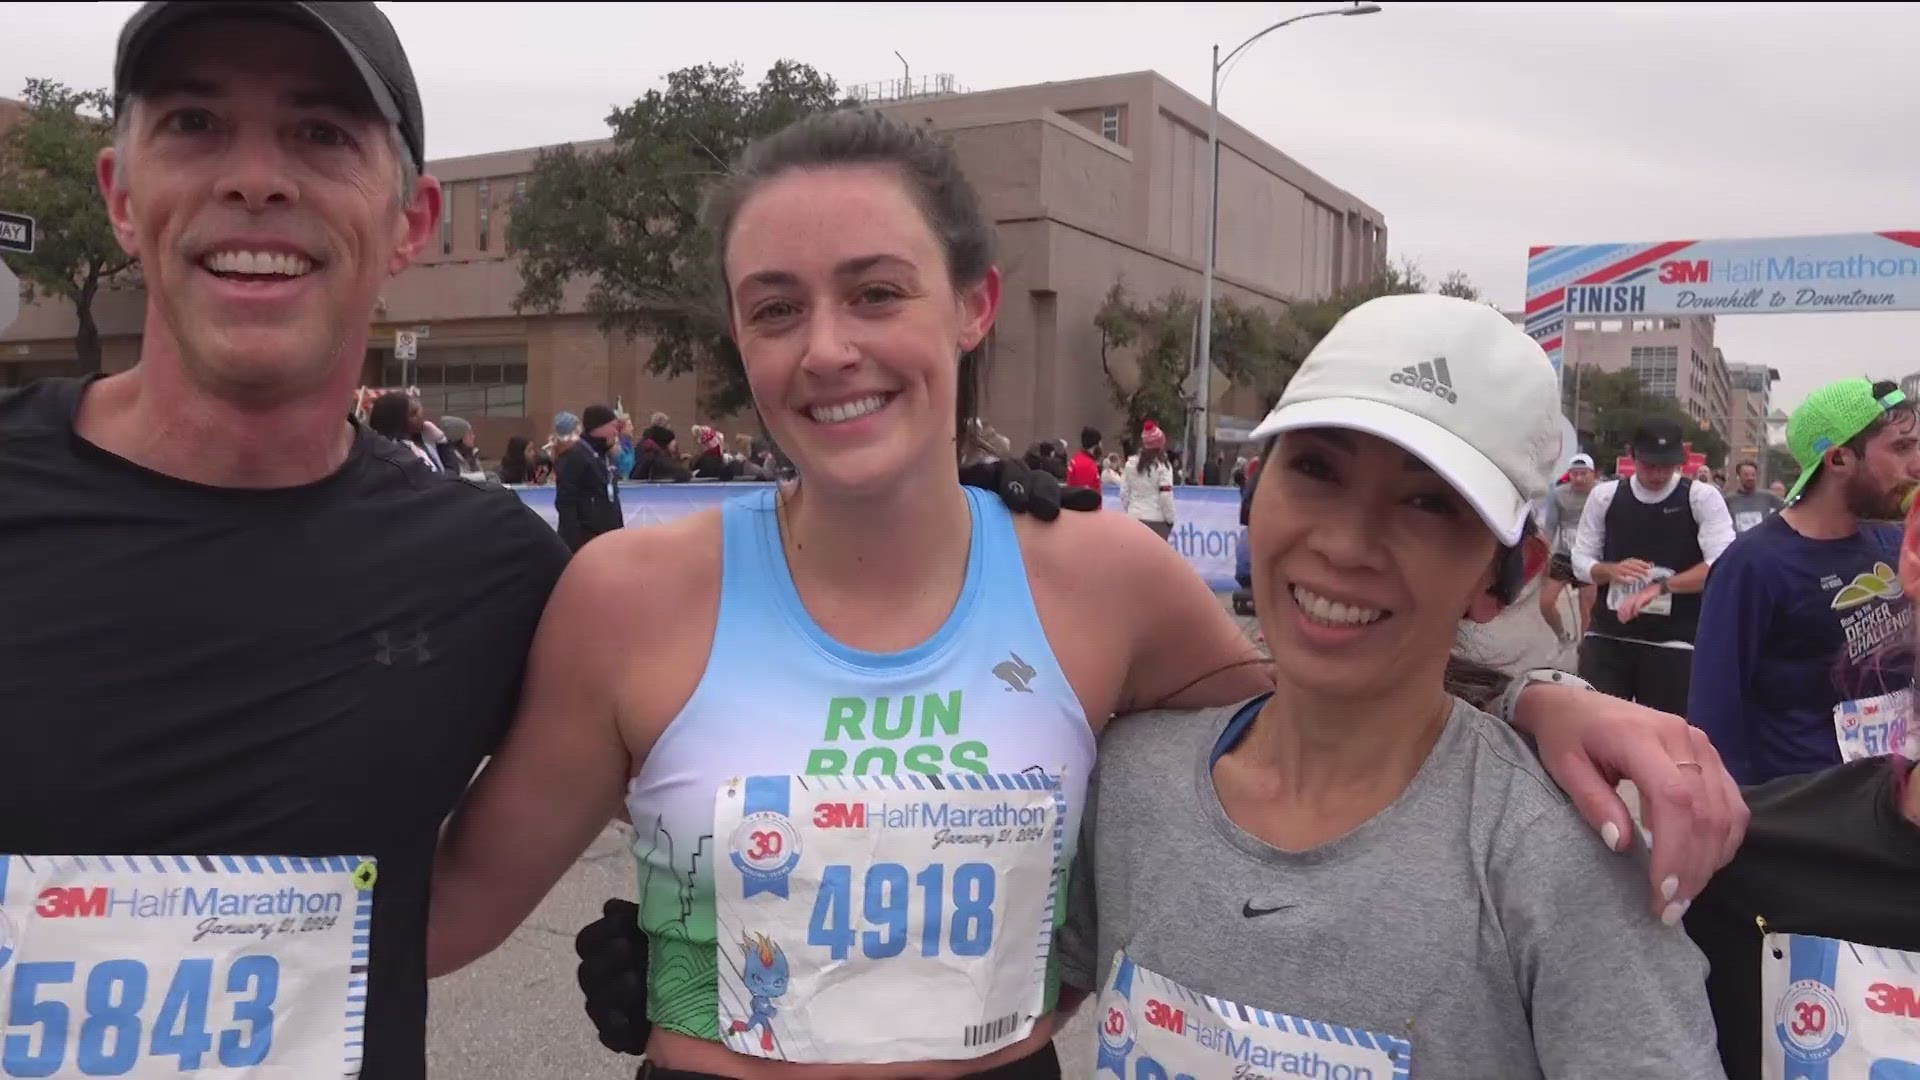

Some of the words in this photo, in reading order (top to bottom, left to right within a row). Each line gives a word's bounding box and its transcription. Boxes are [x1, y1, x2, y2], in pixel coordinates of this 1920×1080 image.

[1658, 260, 1709, 285] 3M
[1710, 257, 1762, 284] Half
[1767, 253, 1918, 281] Marathon
[1566, 286, 1645, 313] FINISH
[1676, 287, 1763, 309] Downhill
[1769, 290, 1786, 307] to
[1795, 288, 1896, 306] Downtown
[1389, 371, 1458, 404] adidas
[1168, 521, 1238, 557] athon
[1844, 602, 1893, 643] DECKER
[1848, 605, 1911, 659] CHALLENG
[823, 690, 964, 742] RUN
[813, 803, 864, 829] 3M
[866, 803, 919, 829] Half
[922, 802, 1045, 828] Marathon
[747, 831, 782, 860] 30
[932, 828, 994, 850] January
[35, 887, 109, 918] 3M
[108, 887, 182, 918] Half
[183, 886, 342, 917] Marathon
[806, 862, 997, 960] 4918
[192, 917, 273, 942] January
[2, 955, 280, 1078] 5843
[1104, 1007, 1125, 1036] 30
[1791, 1001, 1826, 1037] 30
[1144, 998, 1185, 1036] 3M
[1184, 1013, 1226, 1053] Half
[1226, 1031, 1372, 1080] Marathon
